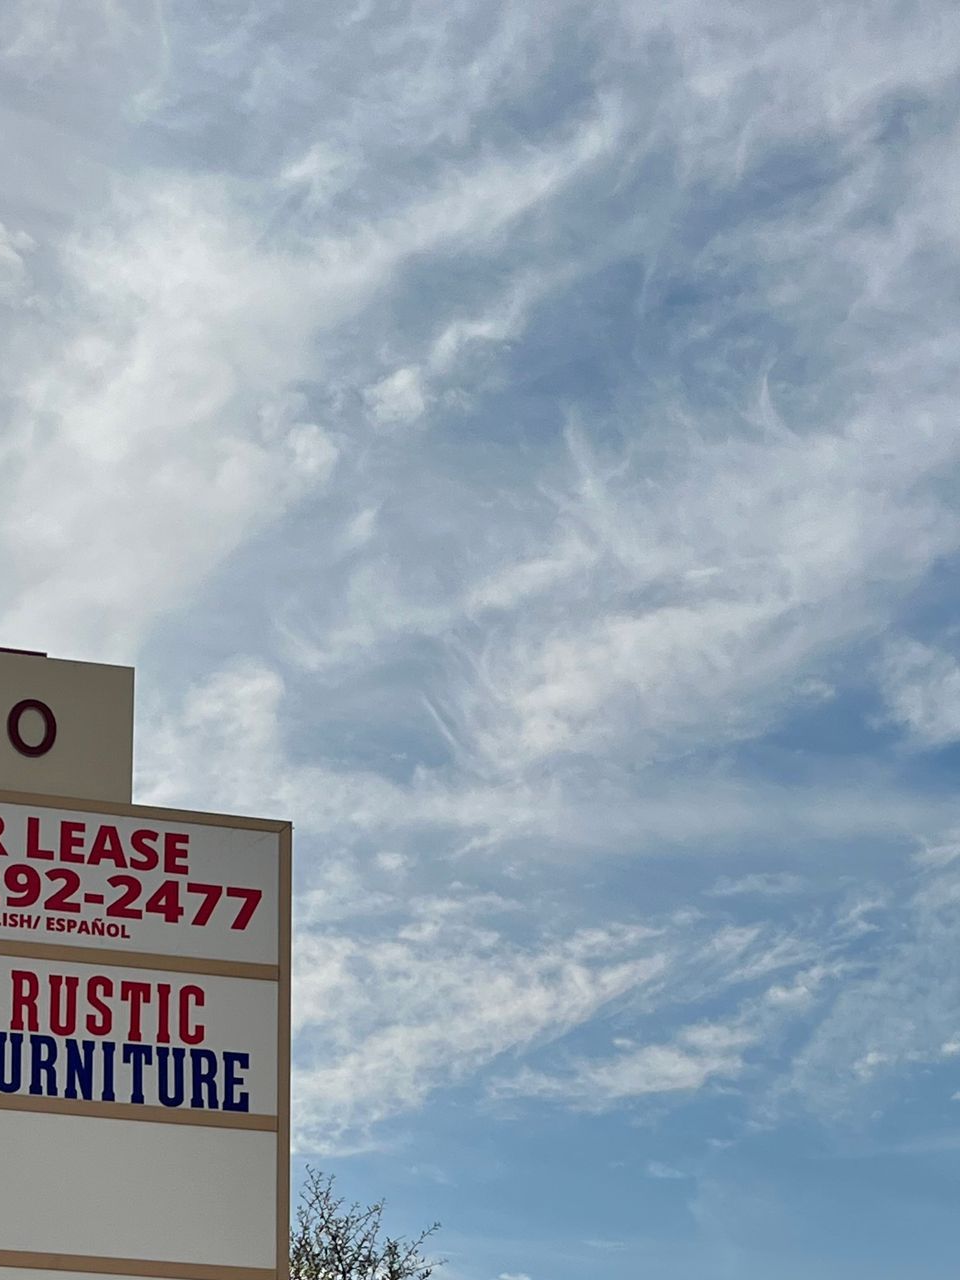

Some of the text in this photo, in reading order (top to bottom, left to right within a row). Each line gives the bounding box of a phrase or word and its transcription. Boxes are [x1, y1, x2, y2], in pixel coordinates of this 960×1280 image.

[26, 816, 190, 876] LEASE
[45, 915, 131, 940] ESPAÑOL
[9, 969, 205, 1046] RUSTIC
